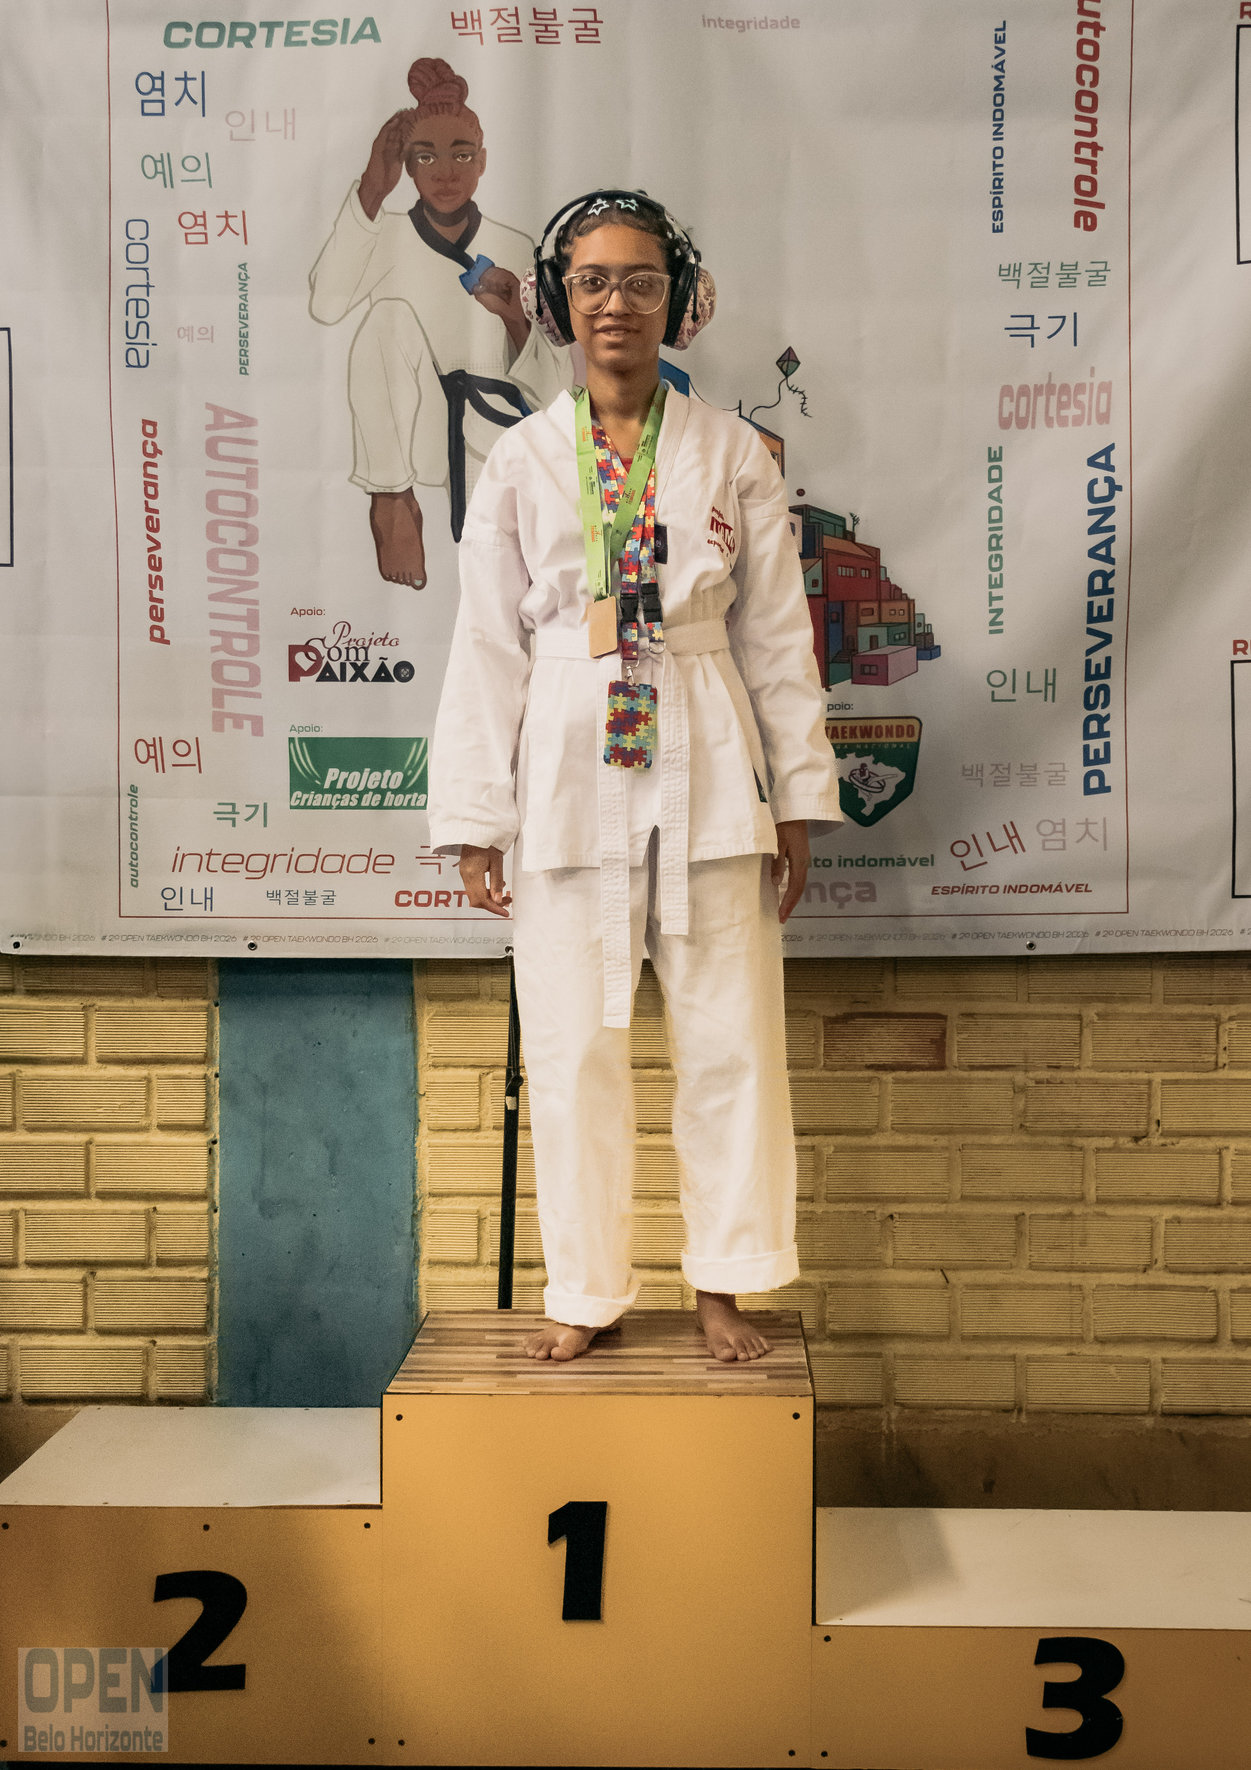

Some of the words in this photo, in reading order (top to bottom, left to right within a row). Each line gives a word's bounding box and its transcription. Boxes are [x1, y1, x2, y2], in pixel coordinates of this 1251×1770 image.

[163, 17, 382, 49] CORTESIA
[450, 7, 605, 46] 백절불굴
[134, 70, 207, 118] 염치
[991, 20, 1007, 142] INDOMÁVEL
[224, 107, 298, 142] 인내
[140, 152, 213, 189] 예의
[989, 144, 1005, 234] ESPÍRITO
[177, 210, 249, 246] 염치
[125, 218, 158, 369] cortesia
[998, 261, 1112, 290] 백절불굴
[177, 325, 215, 344] 예의
[237, 262, 250, 376] PERSEVERANÇA
[1004, 312, 1078, 348] 극기
[999, 366, 1113, 431] cortesia
[140, 418, 171, 646] perseverança
[987, 445, 1003, 635] INTEGRIDADE
[205, 402, 264, 738] AUTOCONTROLE
[290, 607, 326, 617] Apoio:
[1082, 442, 1123, 796] PERSEVERANÇA
[330, 620, 400, 649] Projeto
[288, 644, 415, 683] PAIXÃO
[986, 666, 1057, 703] 인내
[826, 701, 854, 713] poio:
[289, 724, 323, 734] Apoio:
[825, 724, 916, 741] TAEKWONDO
[134, 737, 203, 775] 예의
[324, 768, 404, 790] Projeto
[961, 762, 1069, 788] 백절불굴
[213, 802, 268, 828] 극기
[290, 791, 359, 809] Crianças
[361, 792, 381, 806] de
[383, 791, 427, 807] horta
[127, 784, 138, 888] autocontrole
[949, 820, 1026, 871] 인내
[1036, 816, 1107, 852] 염치
[171, 846, 395, 880] integridade
[837, 853, 935, 868] indomável
[160, 886, 214, 912] 인내
[266, 888, 337, 906] 백절불굴
[930, 883, 999, 896] ESPÍRITO
[1003, 880, 1093, 894] INDOMÁVEL
[121, 934, 144, 942] OPEN
[146, 934, 199, 942] TAEKWONDO
[200, 934, 212, 942] BH
[214, 934, 237, 942] 2026
[287, 935, 341, 943] TAEKWONDO
[997, 931, 1051, 939] TAEKWONDO
[548, 1501, 608, 1622] 1
[151, 1570, 248, 1693] 2
[1025, 1637, 1126, 1759] 3
